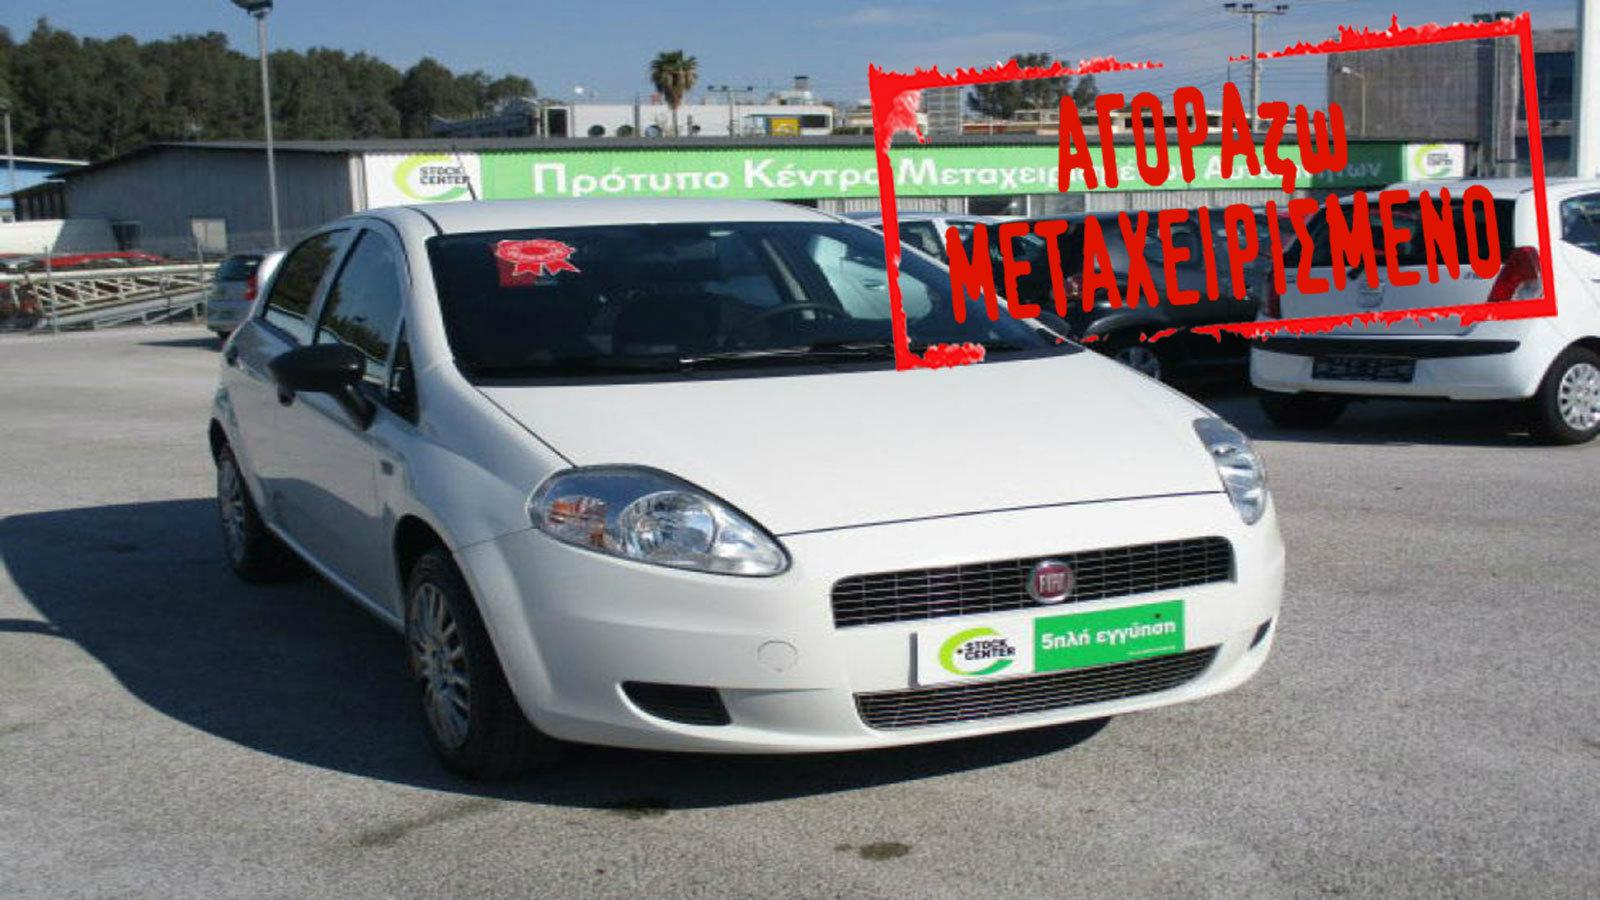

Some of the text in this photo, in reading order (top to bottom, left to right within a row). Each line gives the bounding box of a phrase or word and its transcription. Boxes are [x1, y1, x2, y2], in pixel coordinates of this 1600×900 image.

[533, 162, 730, 197] Πρότυπο
[964, 638, 1007, 652] STOCK
[964, 646, 1016, 661] CENTER
